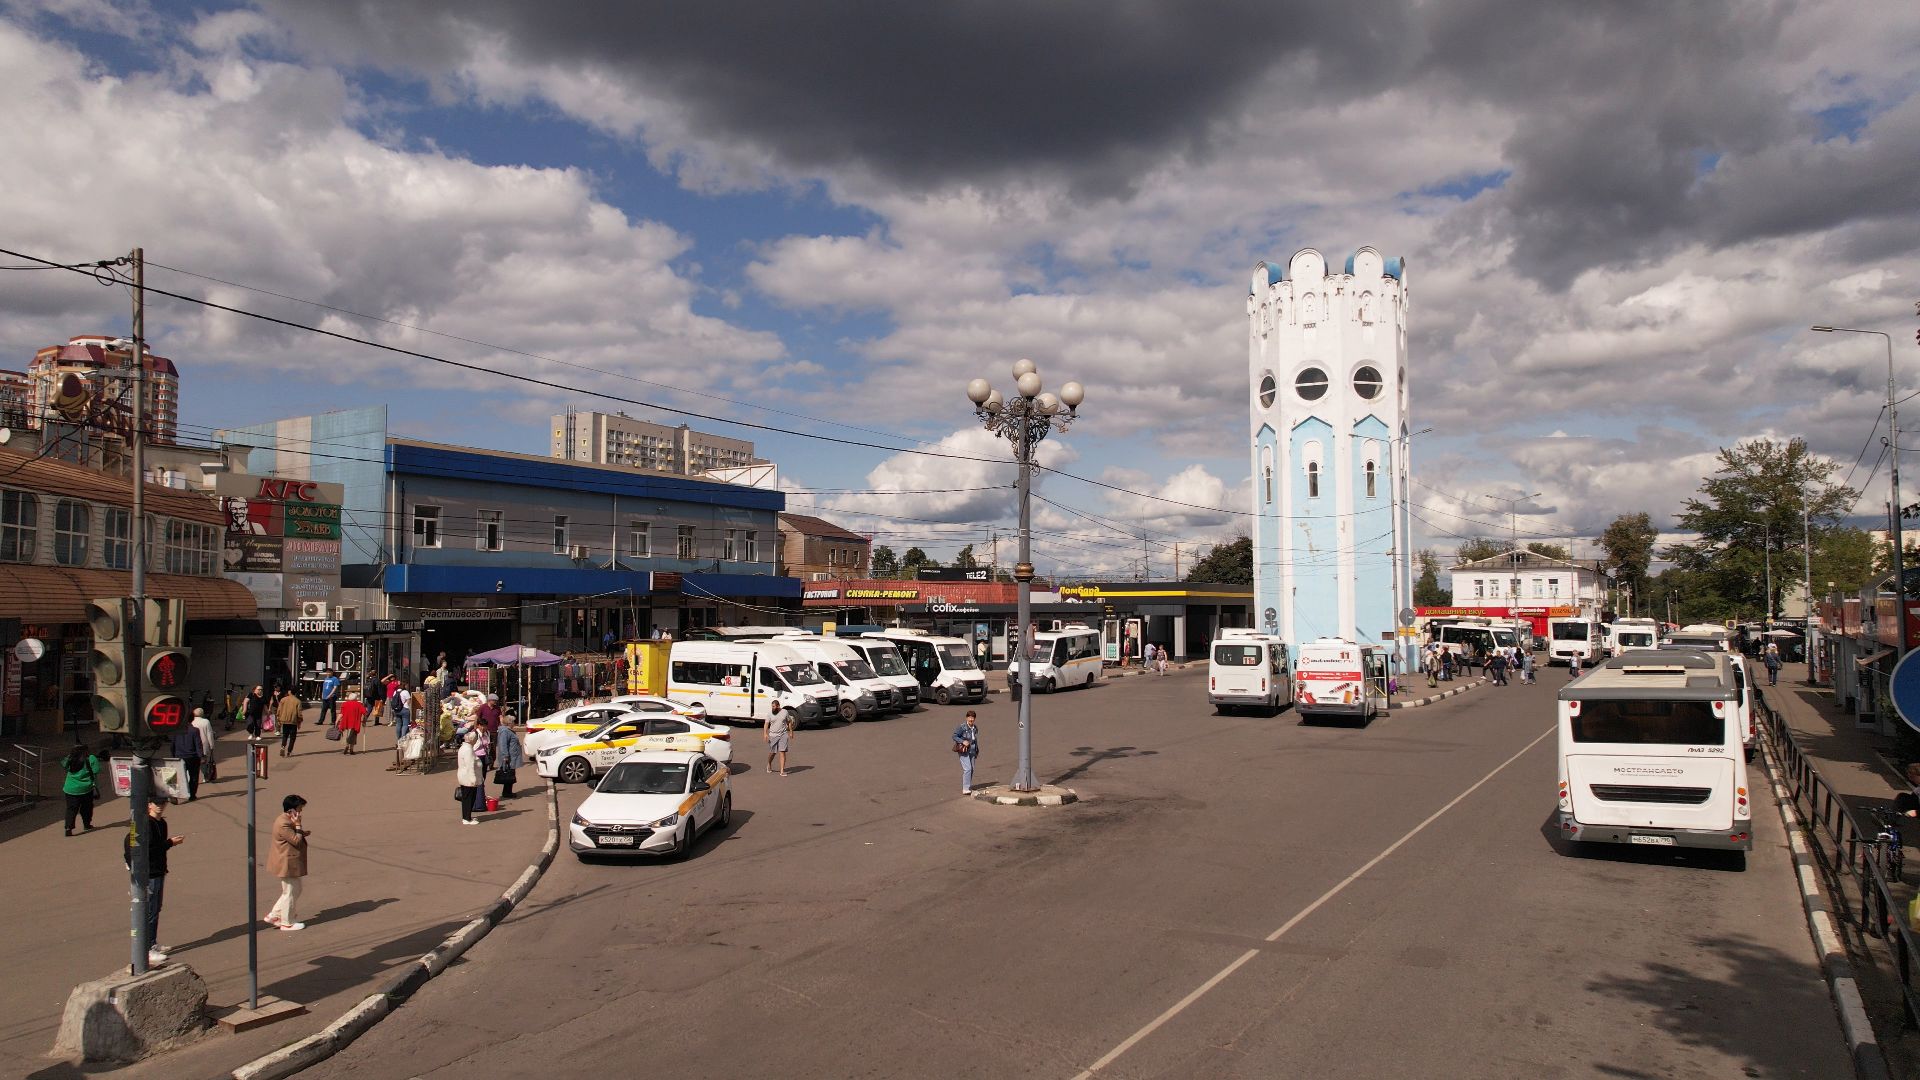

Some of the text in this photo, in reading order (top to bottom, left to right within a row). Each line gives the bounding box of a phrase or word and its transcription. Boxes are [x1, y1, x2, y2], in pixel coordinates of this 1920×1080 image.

[260, 479, 317, 501] KFC
[285, 541, 341, 554] ЛОМБАРД
[965, 570, 987, 580] TELE2
[846, 589, 918, 599] СКУПКА-РЕМОНТ
[1059, 586, 1100, 597] Ломбард
[932, 602, 957, 613] cofix
[1424, 607, 1467, 616] домашний
[420, 610, 508, 620] счастливого пути
[285, 620, 340, 632] PRICE COFFEE
[1613, 767, 1684, 775] МОСТРАНСАВТО
